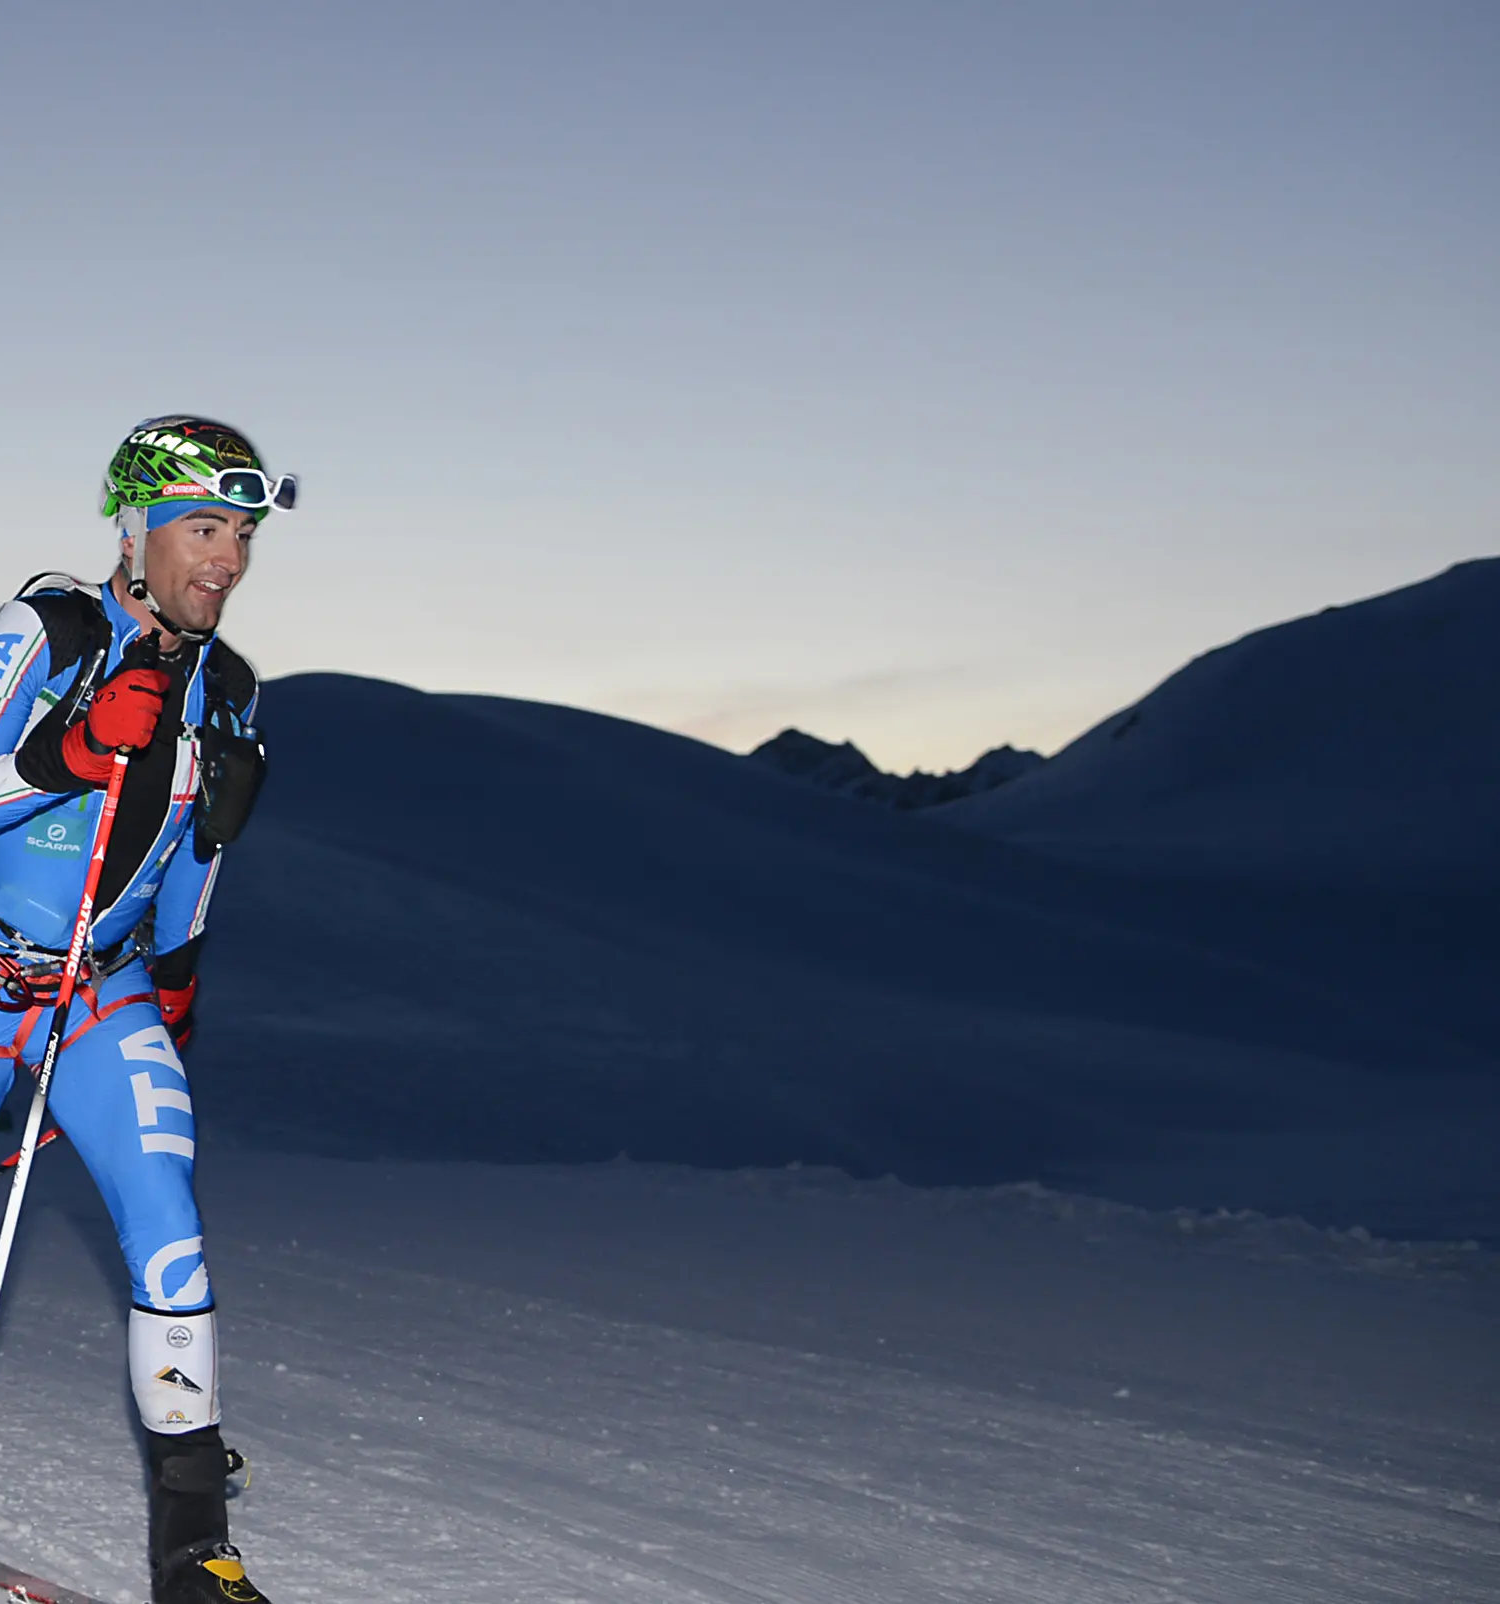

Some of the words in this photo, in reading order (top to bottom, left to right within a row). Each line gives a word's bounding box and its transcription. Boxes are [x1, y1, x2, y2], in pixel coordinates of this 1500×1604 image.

[130, 431, 200, 456] CAMP
[26, 836, 81, 852] SCARPA
[66, 893, 94, 977] ATOMIC
[40, 1031, 59, 1095] redster
[118, 1025, 195, 1161] ITA
